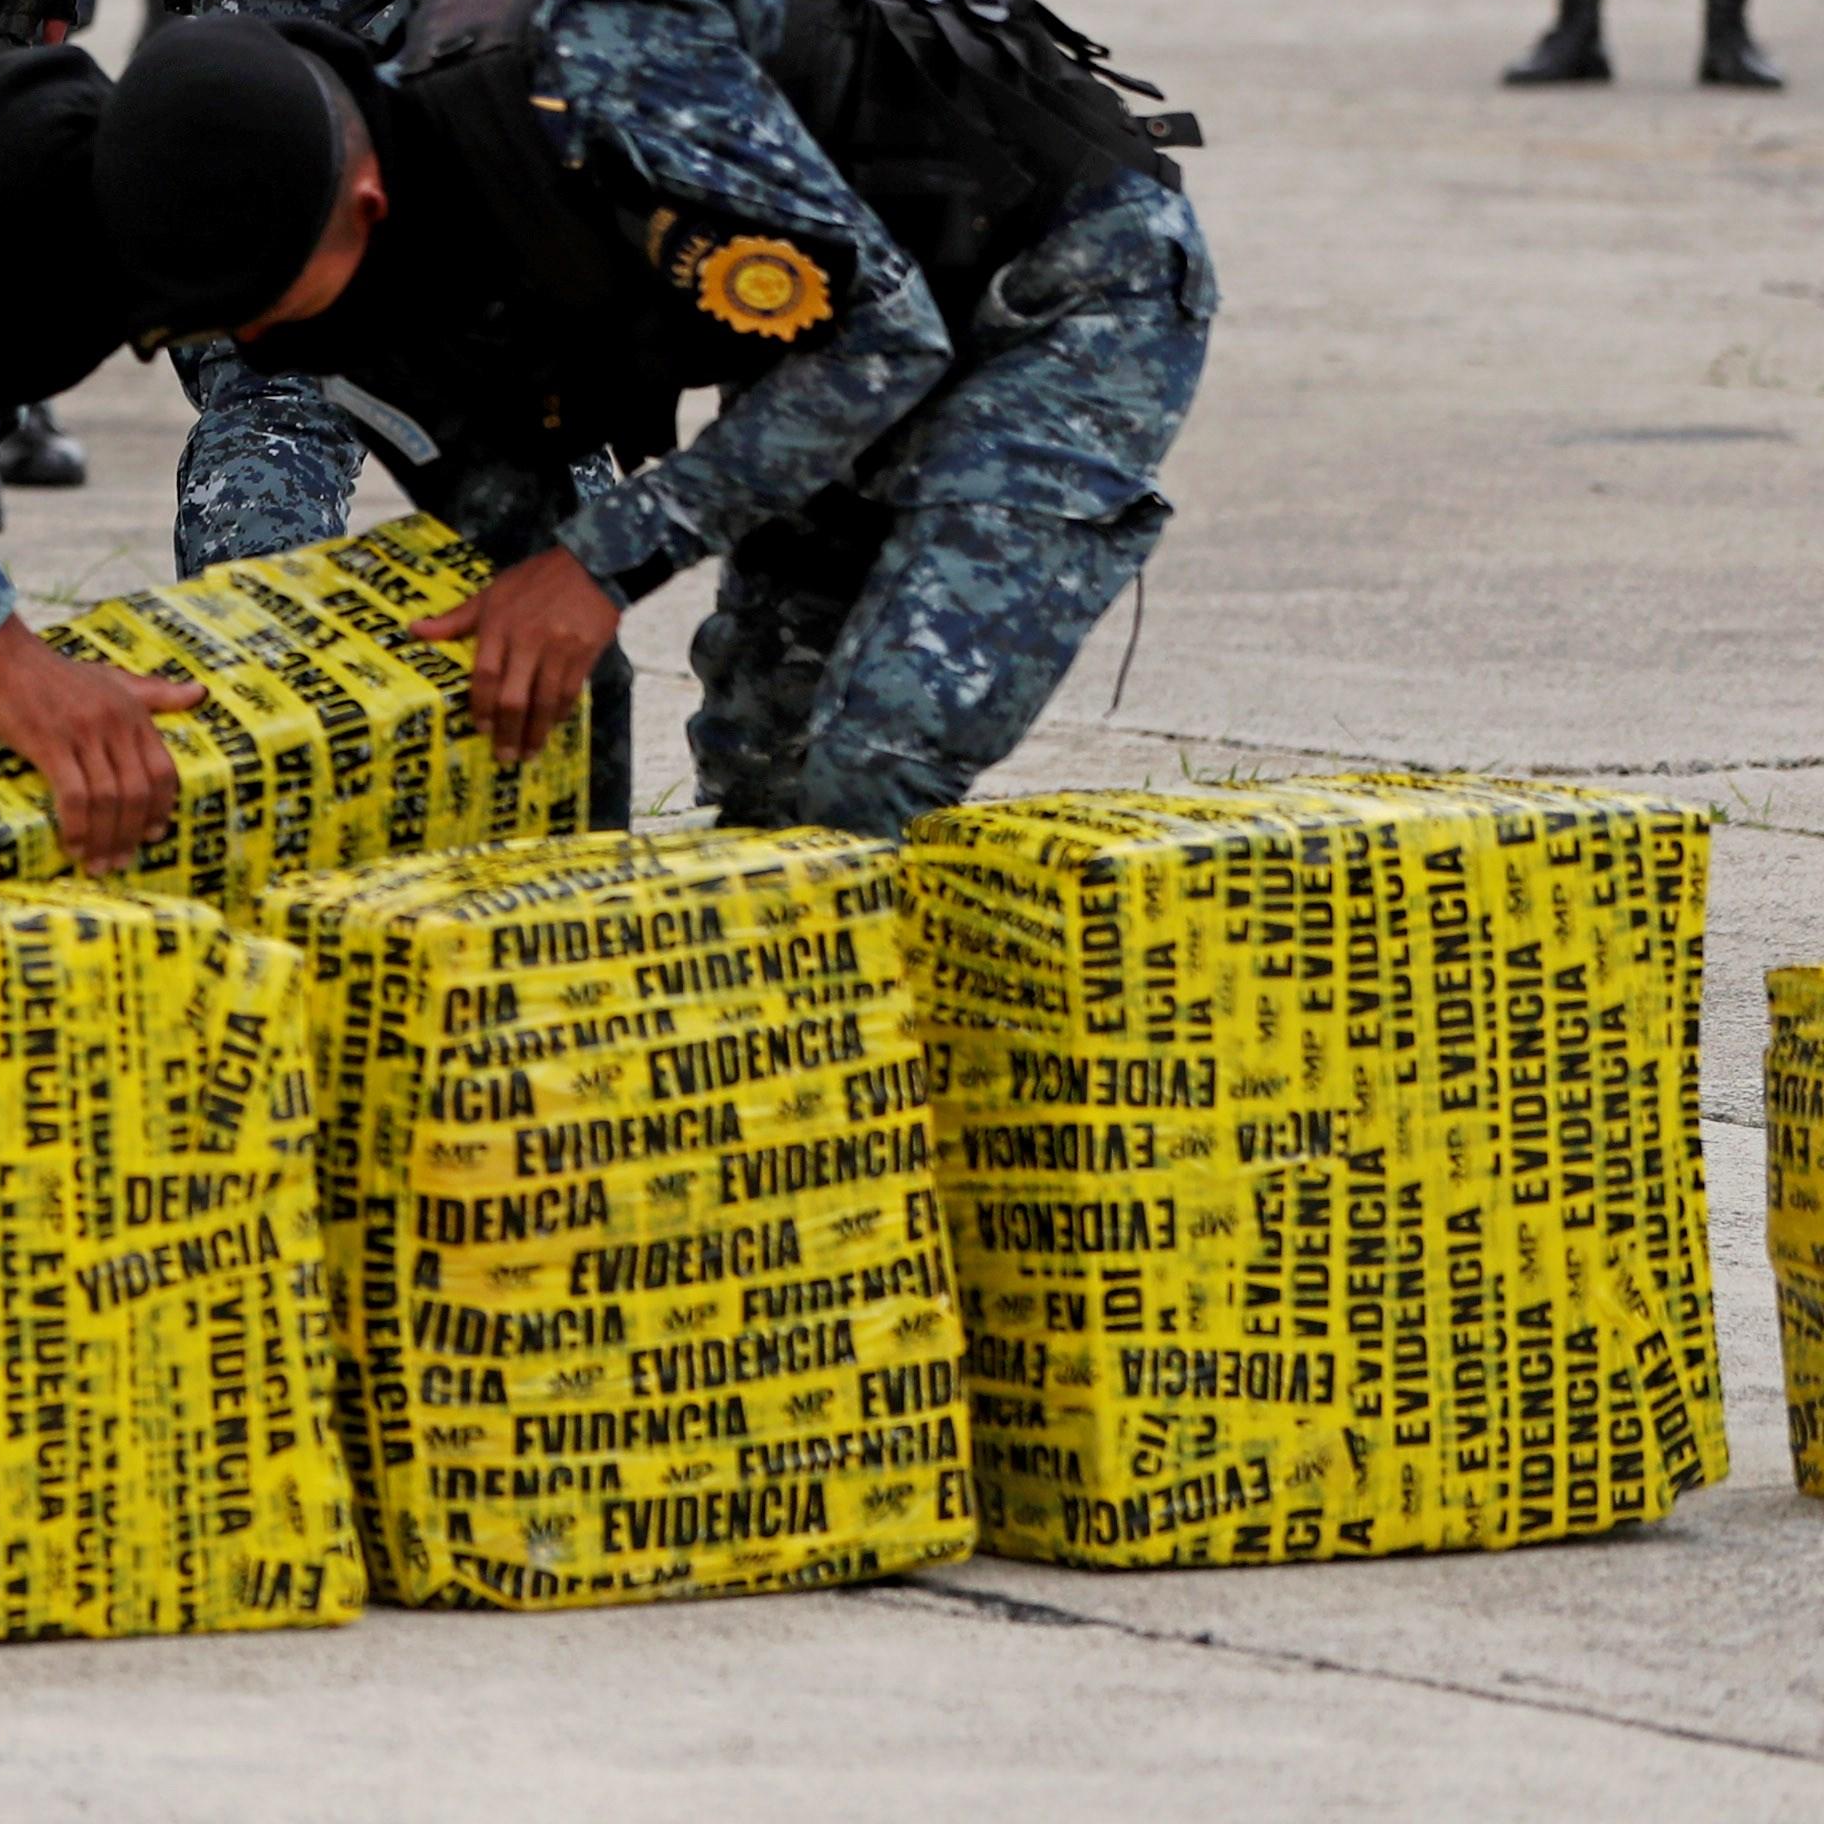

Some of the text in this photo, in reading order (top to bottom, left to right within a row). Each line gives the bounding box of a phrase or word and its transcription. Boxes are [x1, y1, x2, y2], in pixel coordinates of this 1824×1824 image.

[489, 905, 725, 972] EVIDENCIA
[638, 930, 856, 1002] EVIDENCIA
[1425, 845, 1479, 1114] EVIDENCIA
[651, 1020, 864, 1100] EVIDENCIA
[1504, 941, 1551, 1207] EVIDENCIA
[1553, 962, 1597, 1232] EVIDENCIA
[514, 1101, 744, 1178] EVIDENCIA
[718, 1124, 930, 1207] EVIDENCIA
[568, 1217, 802, 1296] EVIDENCIA
[977, 1197, 1176, 1252] EVIDENCIA
[1347, 1145, 1389, 1419] EVIDENCIA
[1393, 1180, 1433, 1447] EVIDENCIA
[628, 1317, 859, 1399] EVIDENCIA
[1119, 1346, 1335, 1404] EVIDENCIA
[1445, 1205, 1489, 1474] EVIDENCIA
[28, 1251, 66, 1523] EVIDENCIA
[514, 1395, 750, 1457] EVIDENCIA
[737, 1416, 959, 1479] EVIDENCIA
[603, 1480, 830, 1554] EVIDENCIA
[1058, 1455, 1274, 1547] EVIDENCIA
